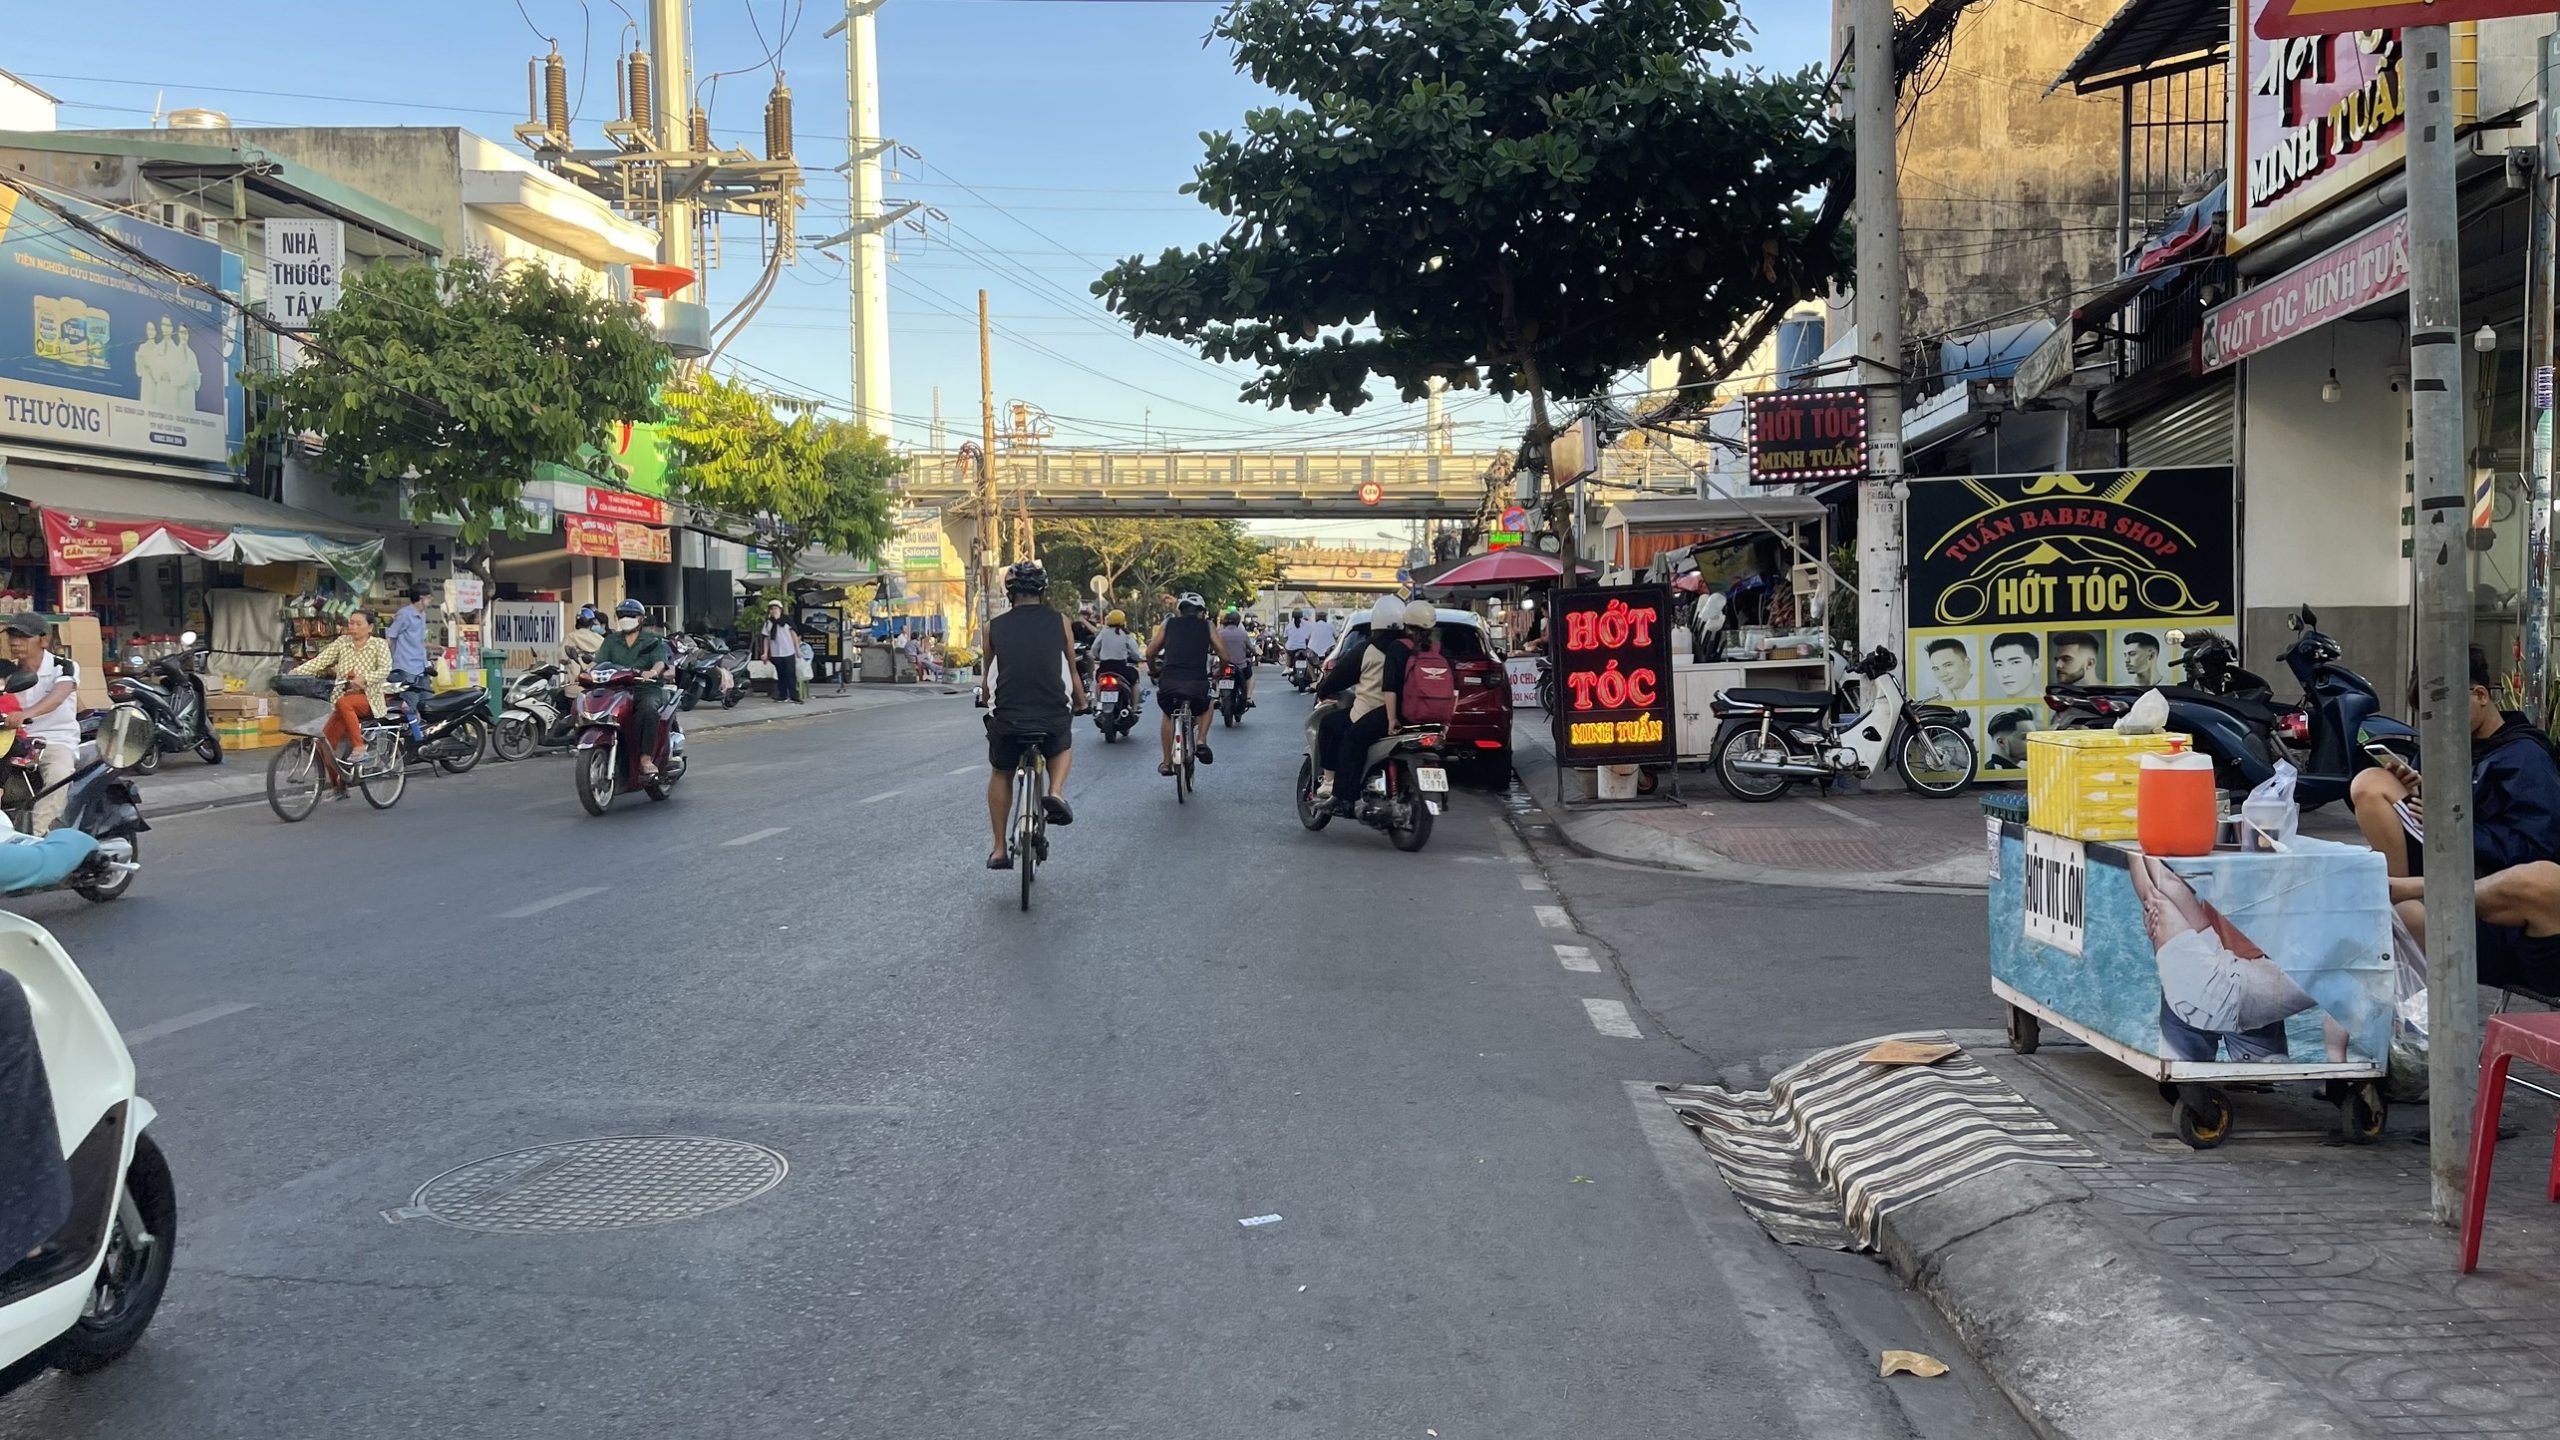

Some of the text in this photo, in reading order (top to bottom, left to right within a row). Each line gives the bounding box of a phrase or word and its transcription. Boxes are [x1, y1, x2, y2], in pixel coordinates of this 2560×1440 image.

[2248, 118, 2318, 207] MINH
[282, 227, 318, 254] NHÀ
[14, 252, 35, 268] VIỆN
[36, 257, 69, 276] NGHIÊN
[273, 257, 331, 286] THUỐC
[285, 291, 322, 317] TÂY
[2220, 215, 2409, 356] HỚT TÓC MINH TUẤ
[4, 395, 100, 433] THƯỜNG
[1758, 401, 1858, 442] HỚT TÓC
[1760, 440, 1860, 470] MINH TUẤN
[904, 548, 939, 558] Salonpas
[1945, 507, 2179, 562] TUẤN BABER SHOP
[1998, 567, 2128, 615] HỚT TÓC
[496, 606, 555, 643] NHÀ THUỐC TÂY
[1566, 599, 1657, 650] HỚT
[1568, 659, 1656, 709] TÓC
[1571, 712, 1663, 744] MINH TUẤN
[2026, 842, 2043, 928] HỘT
[2046, 858, 2060, 934] VỊT
[2063, 851, 2084, 940] LỘN
